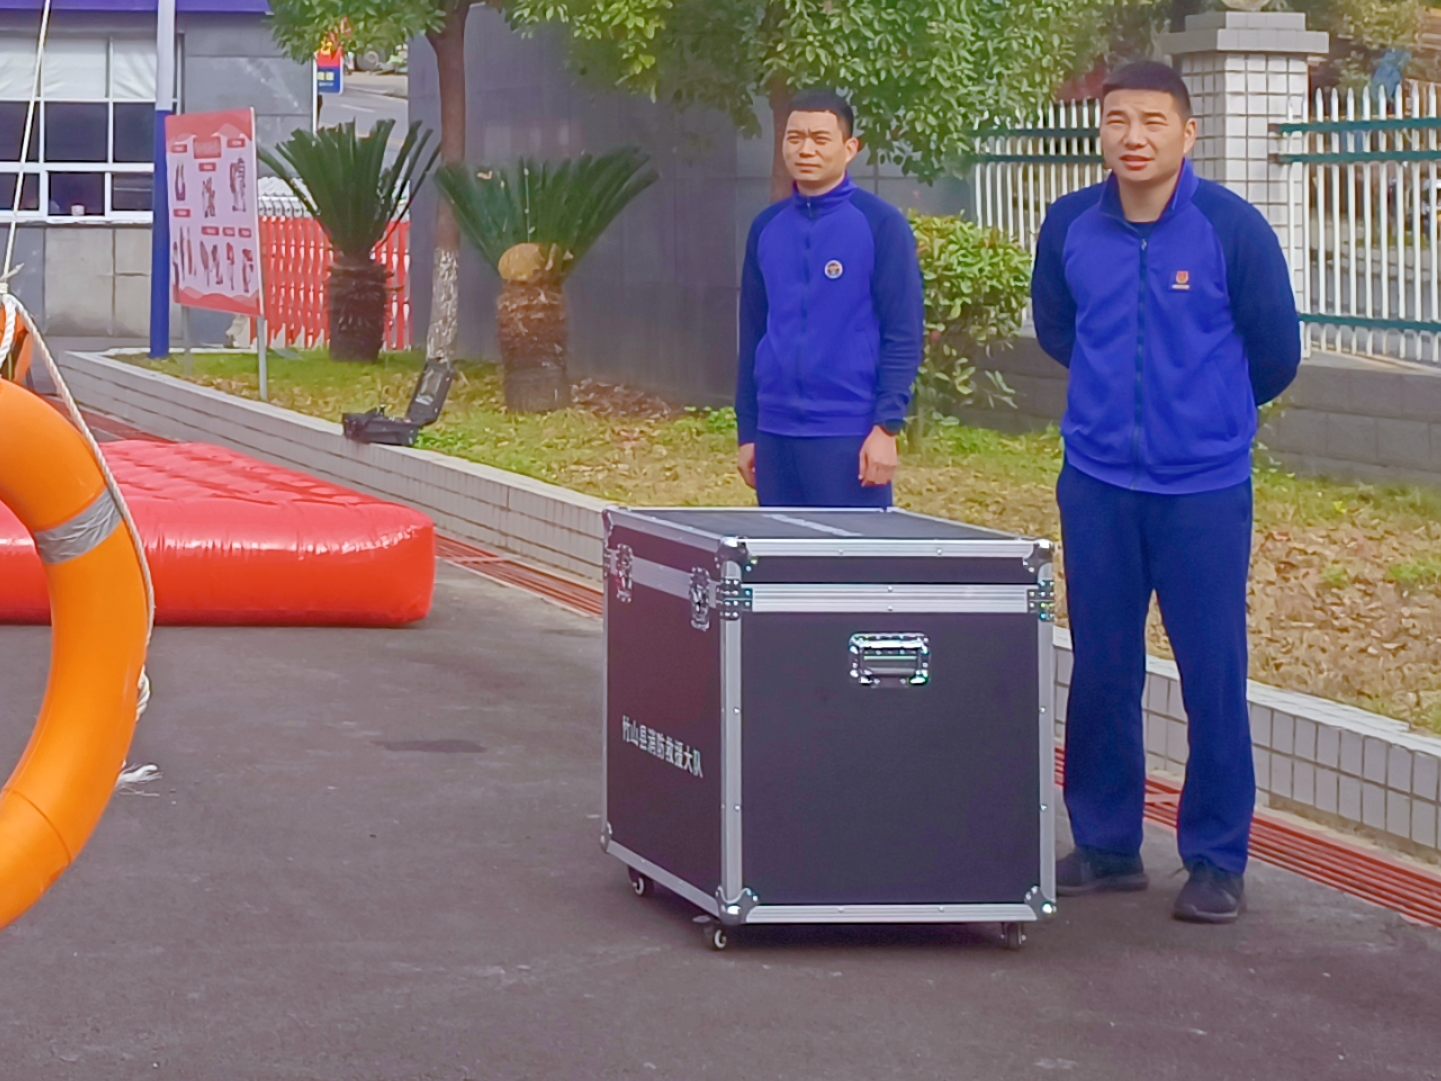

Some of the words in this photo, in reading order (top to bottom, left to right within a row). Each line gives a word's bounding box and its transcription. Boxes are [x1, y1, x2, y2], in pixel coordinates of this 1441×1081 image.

[621, 714, 703, 779] 竹山县消防救援大队
